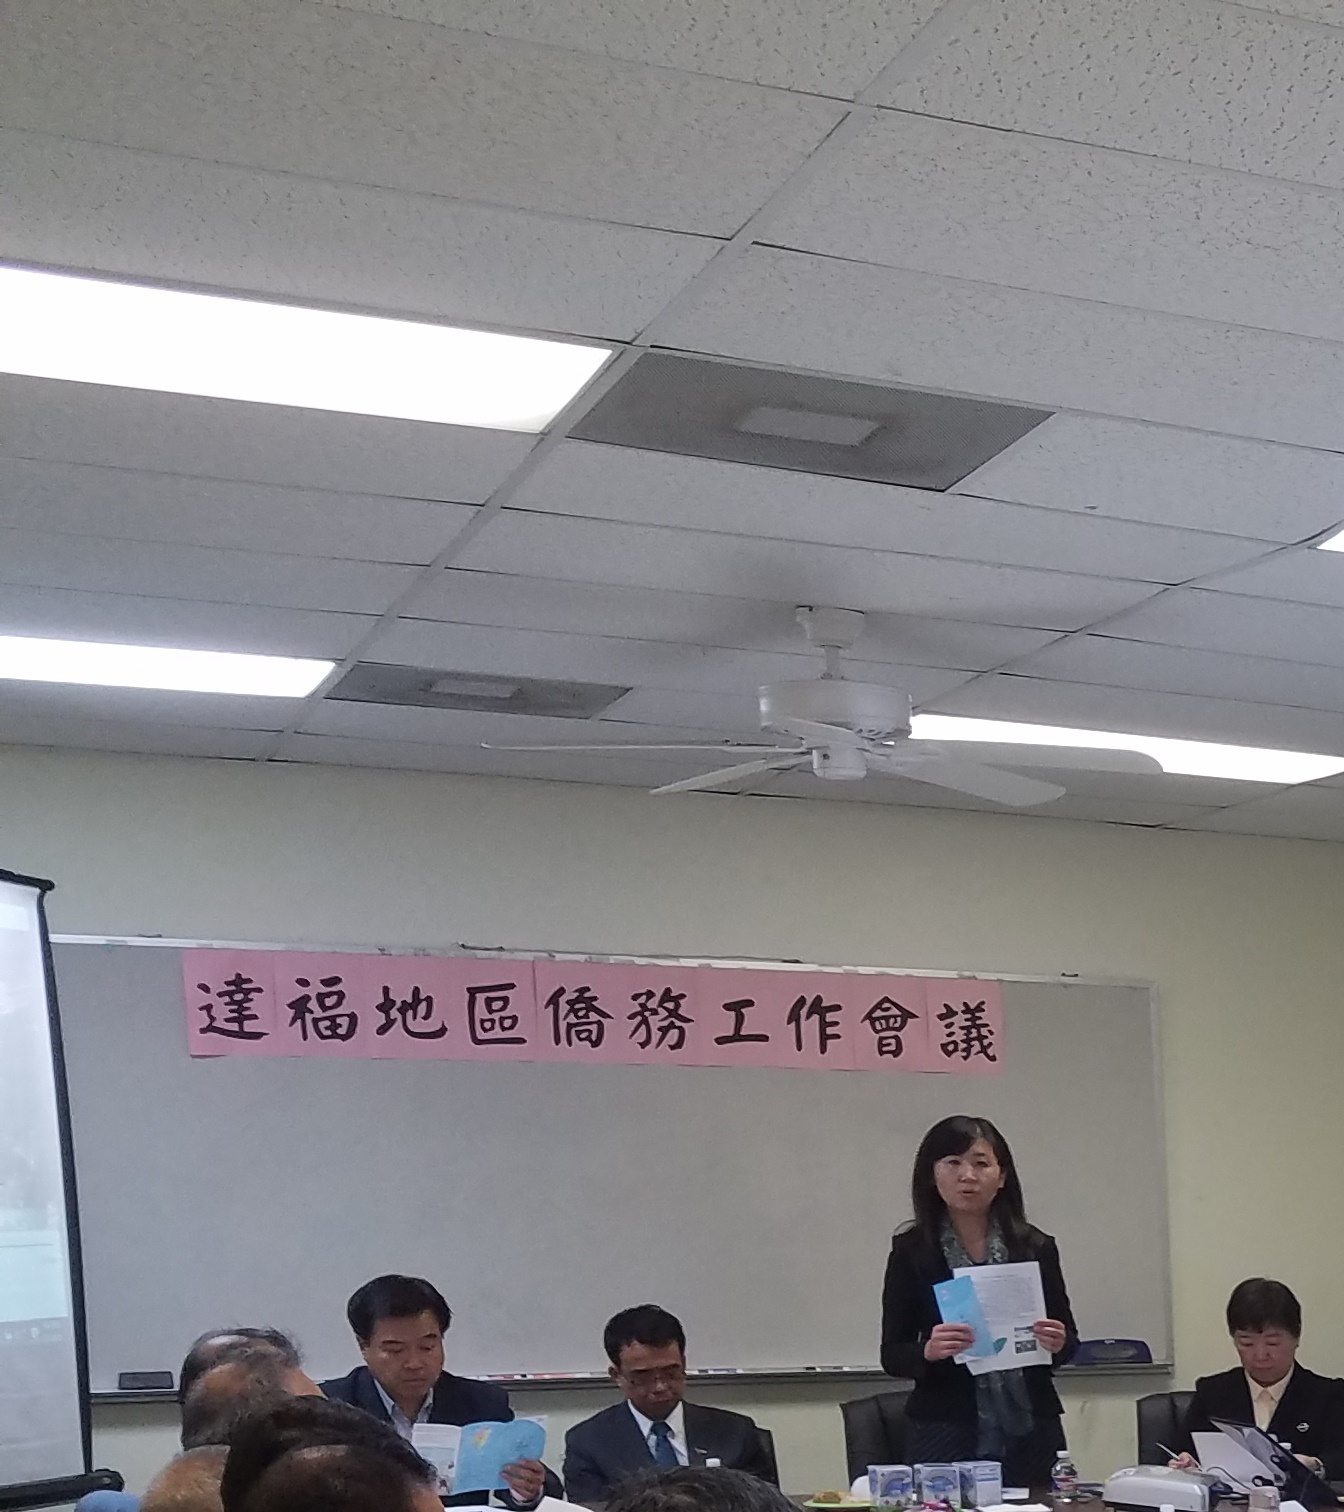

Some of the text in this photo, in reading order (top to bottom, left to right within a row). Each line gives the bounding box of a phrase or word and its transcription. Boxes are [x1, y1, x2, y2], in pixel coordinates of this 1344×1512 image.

[197, 972, 998, 1063] 達福地區僑務工作會議
